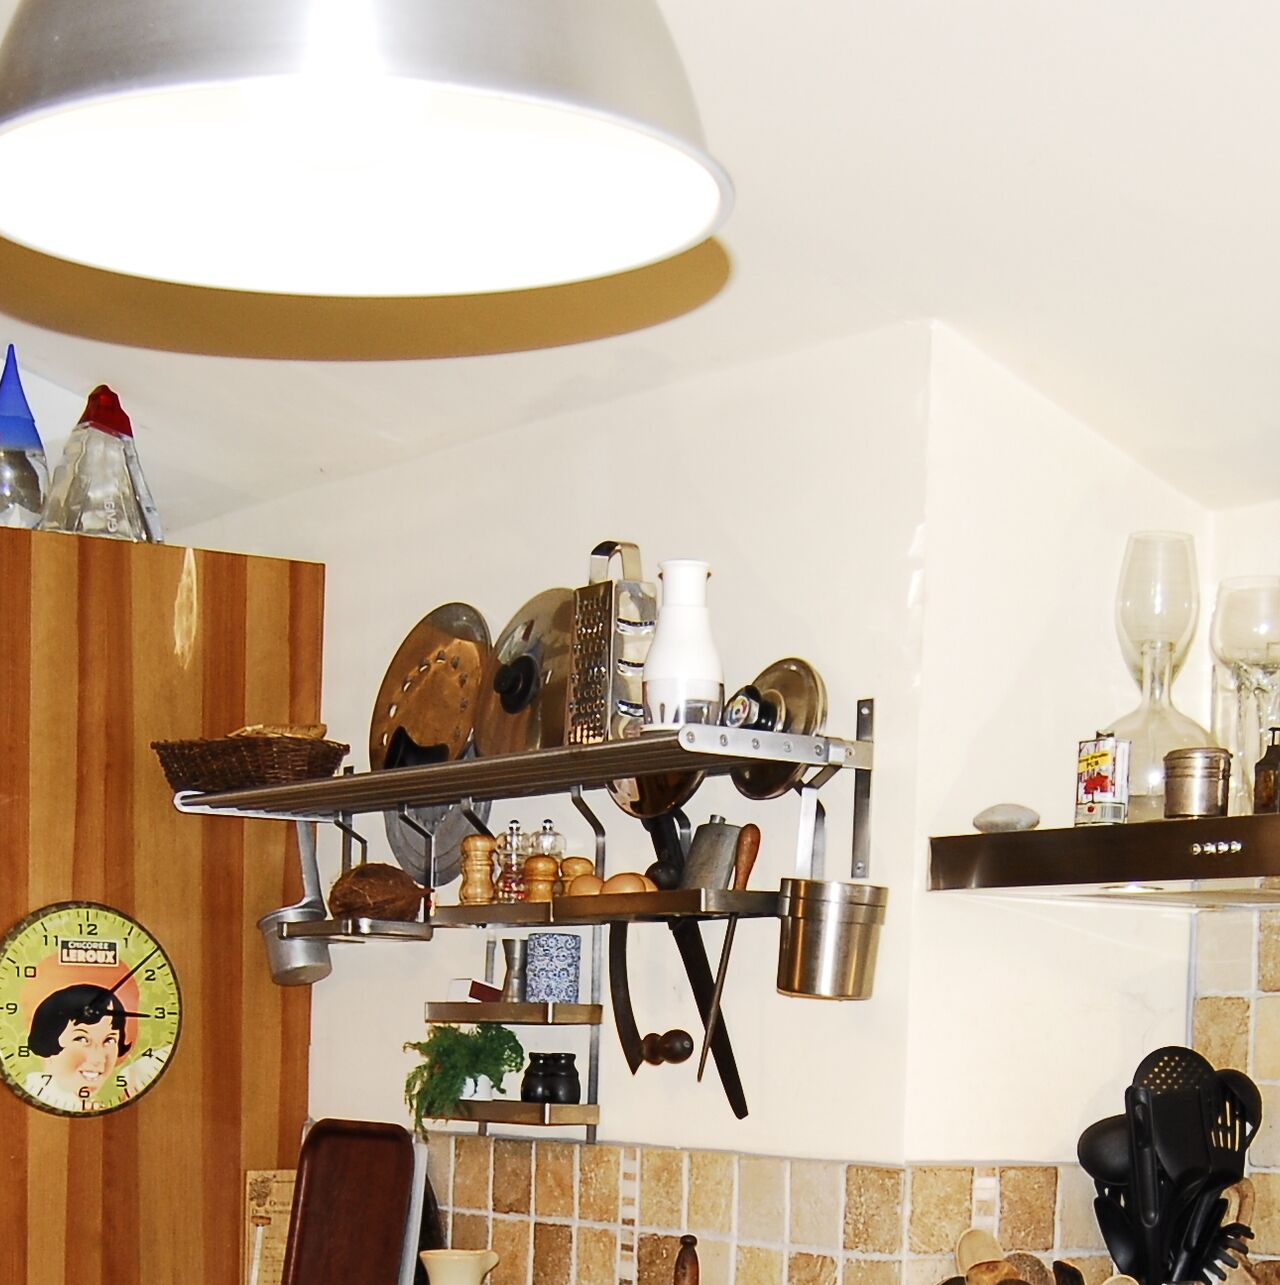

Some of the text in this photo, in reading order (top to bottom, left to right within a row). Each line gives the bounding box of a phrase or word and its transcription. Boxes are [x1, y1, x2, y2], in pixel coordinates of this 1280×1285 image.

[78, 924, 98, 936] 12
[43, 935, 58, 947] 11
[62, 948, 116, 963] LEROUX
[15, 966, 37, 978] 10
[144, 970, 157, 981] 2
[5, 1003, 18, 1014] 9
[154, 1007, 166, 1019] 3
[18, 1046, 30, 1058] 8
[141, 1048, 154, 1058] 4
[41, 1075, 53, 1086] 7
[116, 1076, 128, 1087] 5
[79, 1086, 90, 1098] 6
